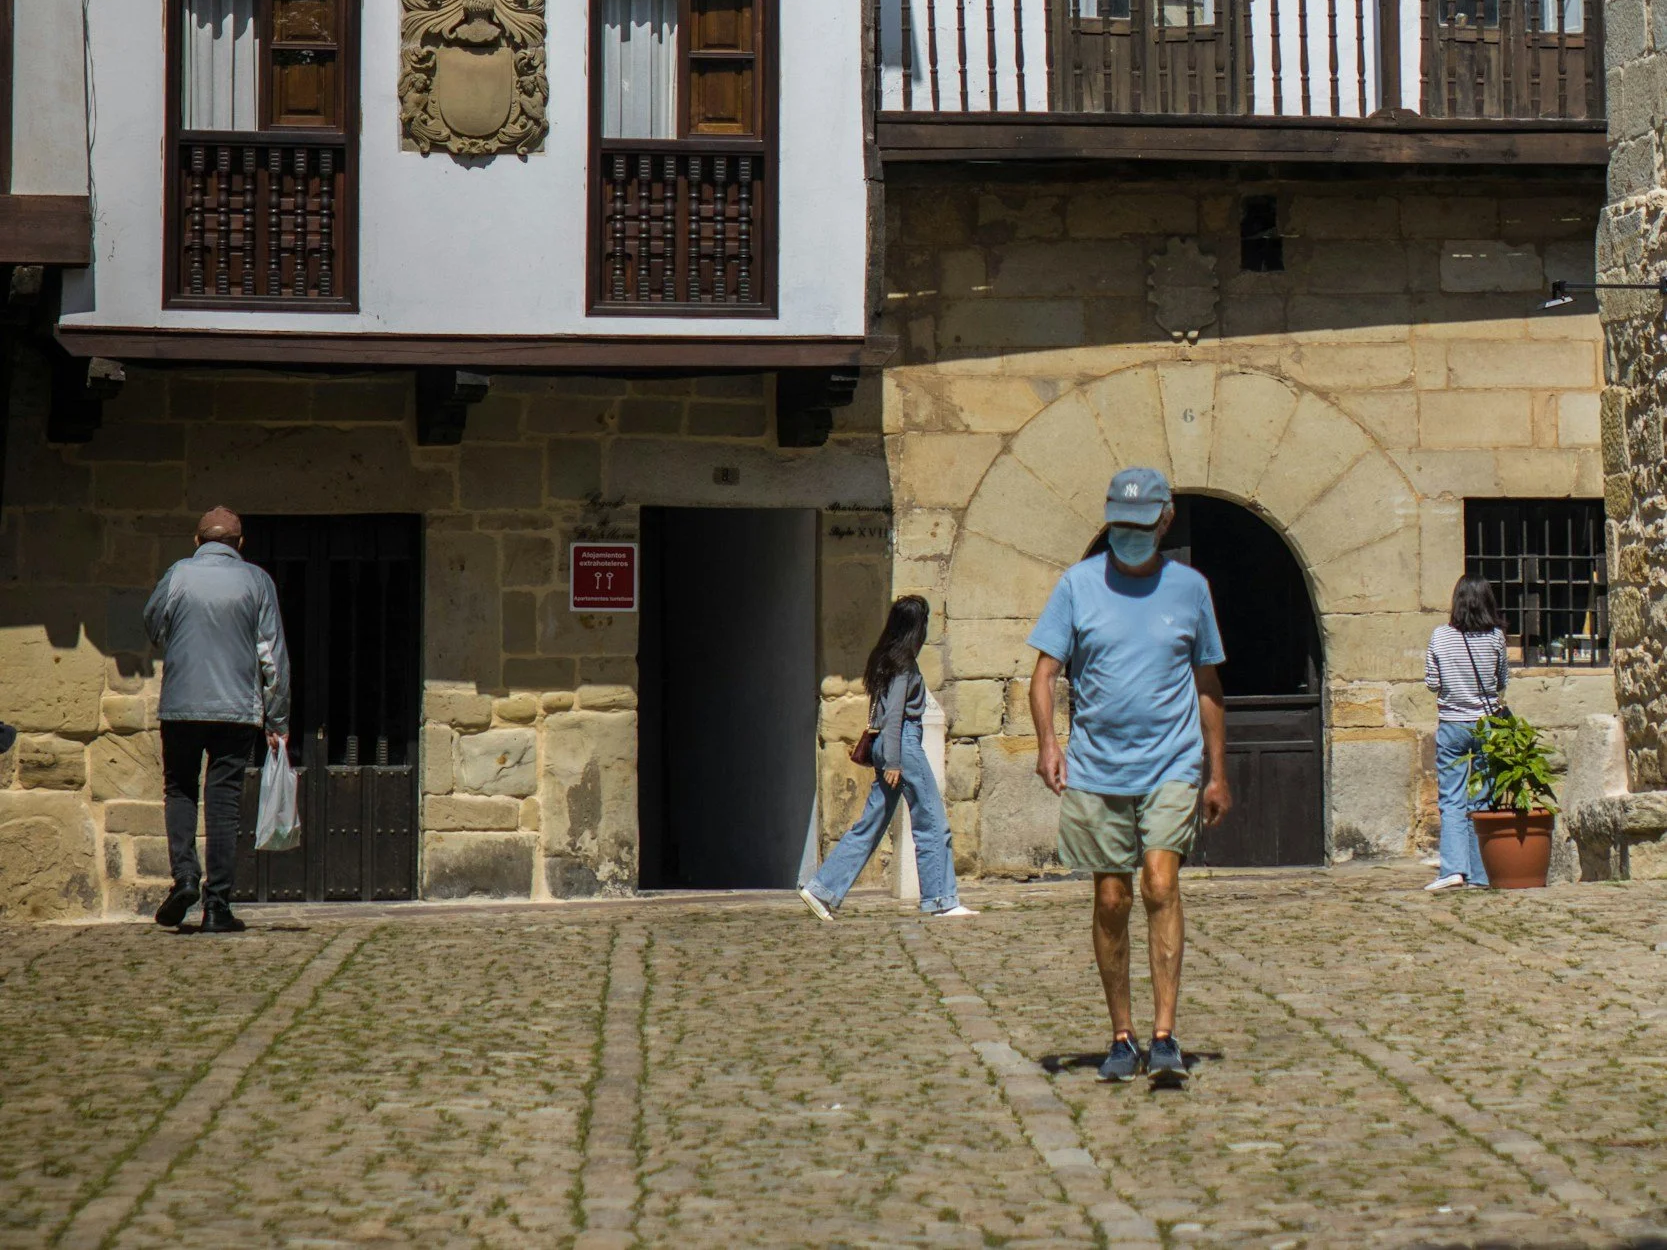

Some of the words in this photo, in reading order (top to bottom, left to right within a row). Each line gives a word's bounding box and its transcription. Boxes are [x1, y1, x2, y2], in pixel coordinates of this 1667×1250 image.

[1183, 408, 1195, 423] 6
[1124, 483, 1138, 497] NY
[581, 551, 627, 560] Alojamientos
